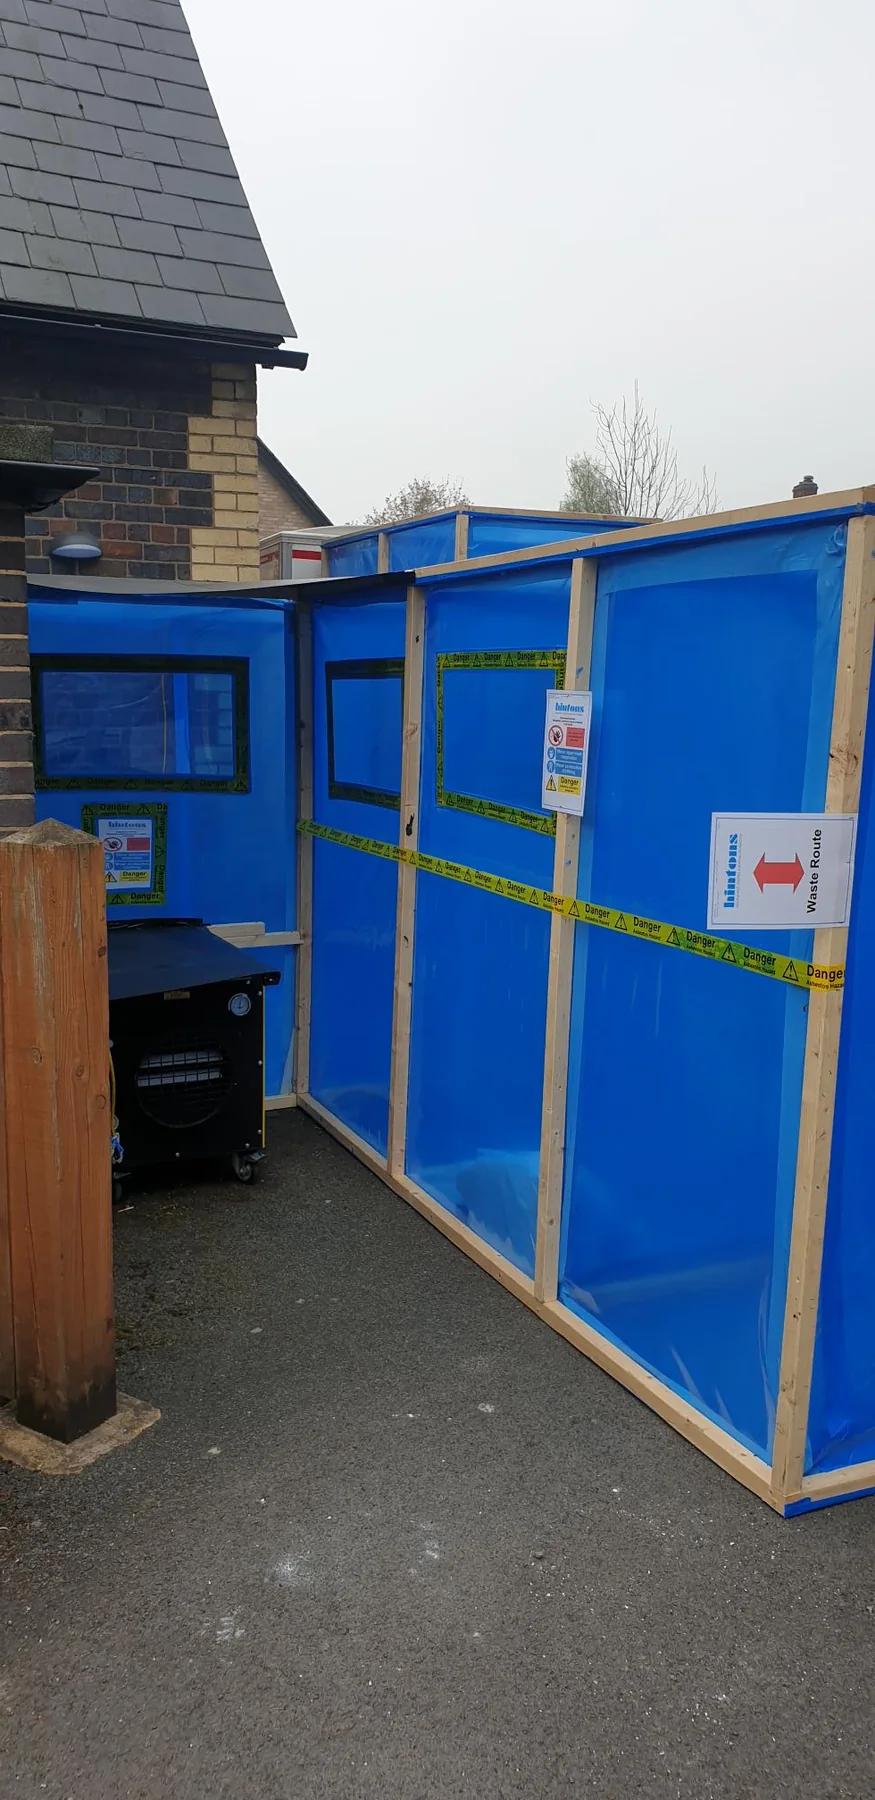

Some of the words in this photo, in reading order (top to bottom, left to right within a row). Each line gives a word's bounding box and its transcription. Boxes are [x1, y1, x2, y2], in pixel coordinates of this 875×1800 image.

[560, 776, 579, 786] Danger
[810, 829, 822, 868] Route
[723, 833, 738, 908] hintons
[806, 872, 819, 914] Waste
[474, 870, 492, 883] Danger
[507, 880, 526, 894] Danger
[543, 891, 565, 906] Danger
[585, 903, 610, 918] Danger
[633, 916, 661, 932] Danger
[686, 930, 716, 948] Danger
[743, 946, 777, 966] Danger
[807, 964, 844, 983] Dange
